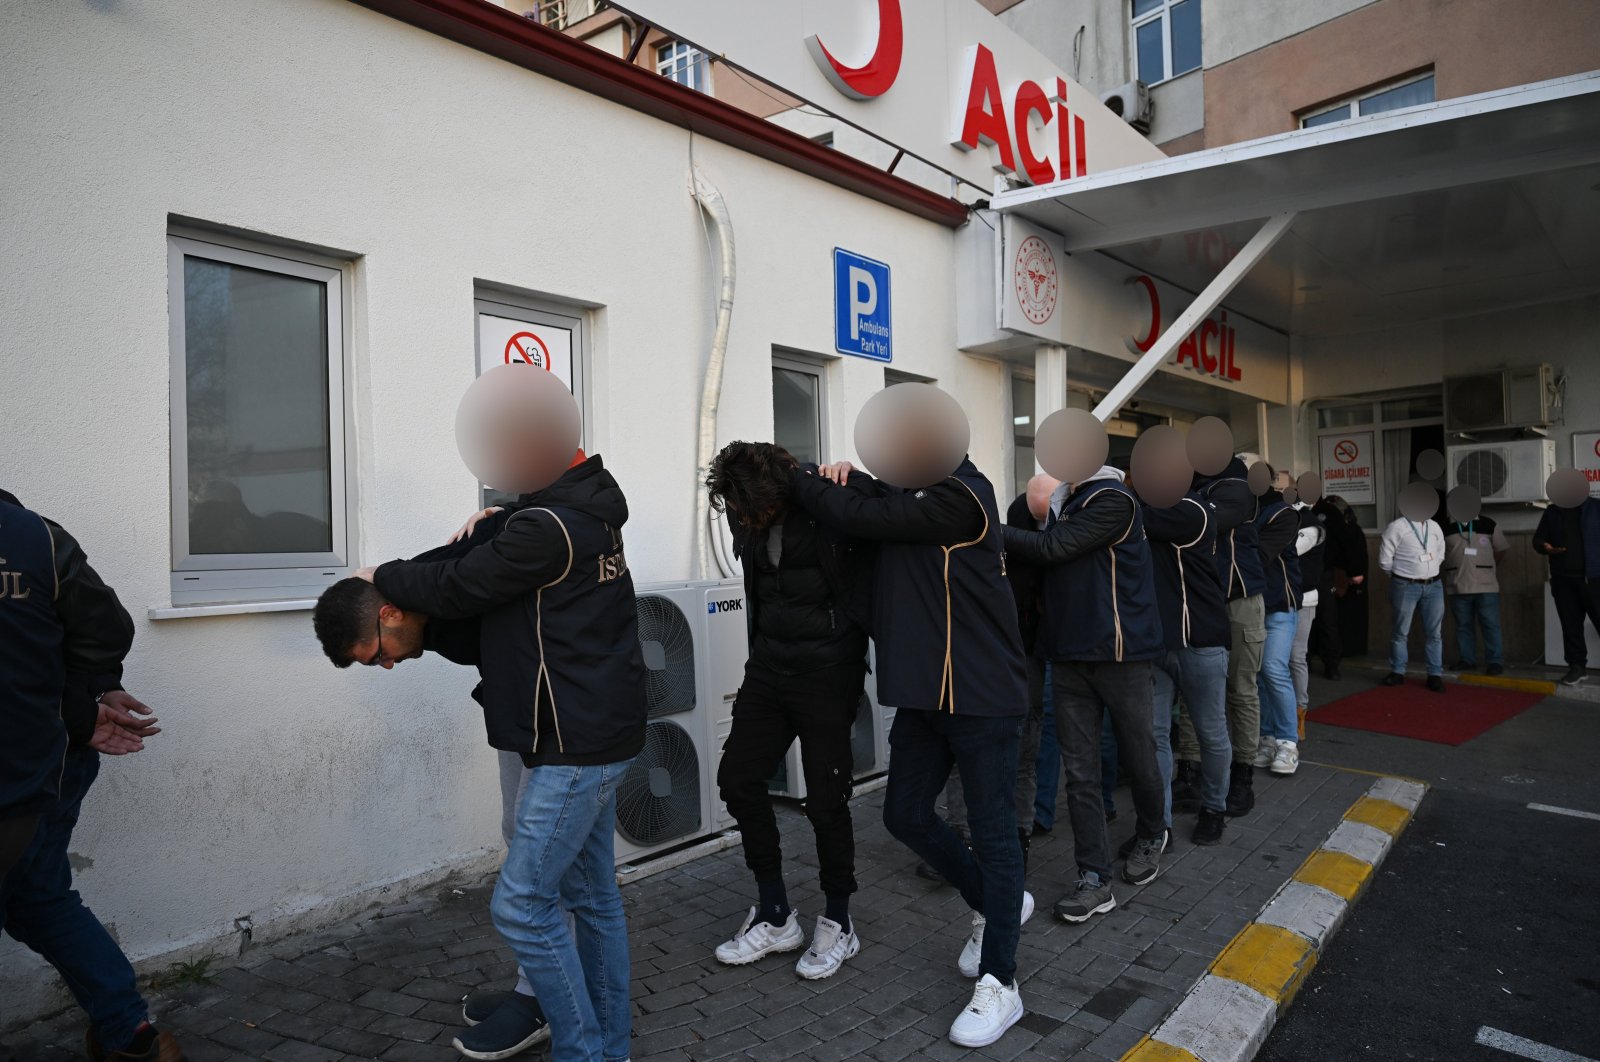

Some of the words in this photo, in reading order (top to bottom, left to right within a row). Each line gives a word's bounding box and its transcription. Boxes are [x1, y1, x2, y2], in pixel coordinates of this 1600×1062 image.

[849, 265, 877, 340] P
[859, 318, 888, 337] Ambulans
[861, 337, 875, 352] Park
[876, 341, 888, 356] Yeri
[1176, 310, 1242, 382] ACİL
[716, 598, 743, 613] YORK
